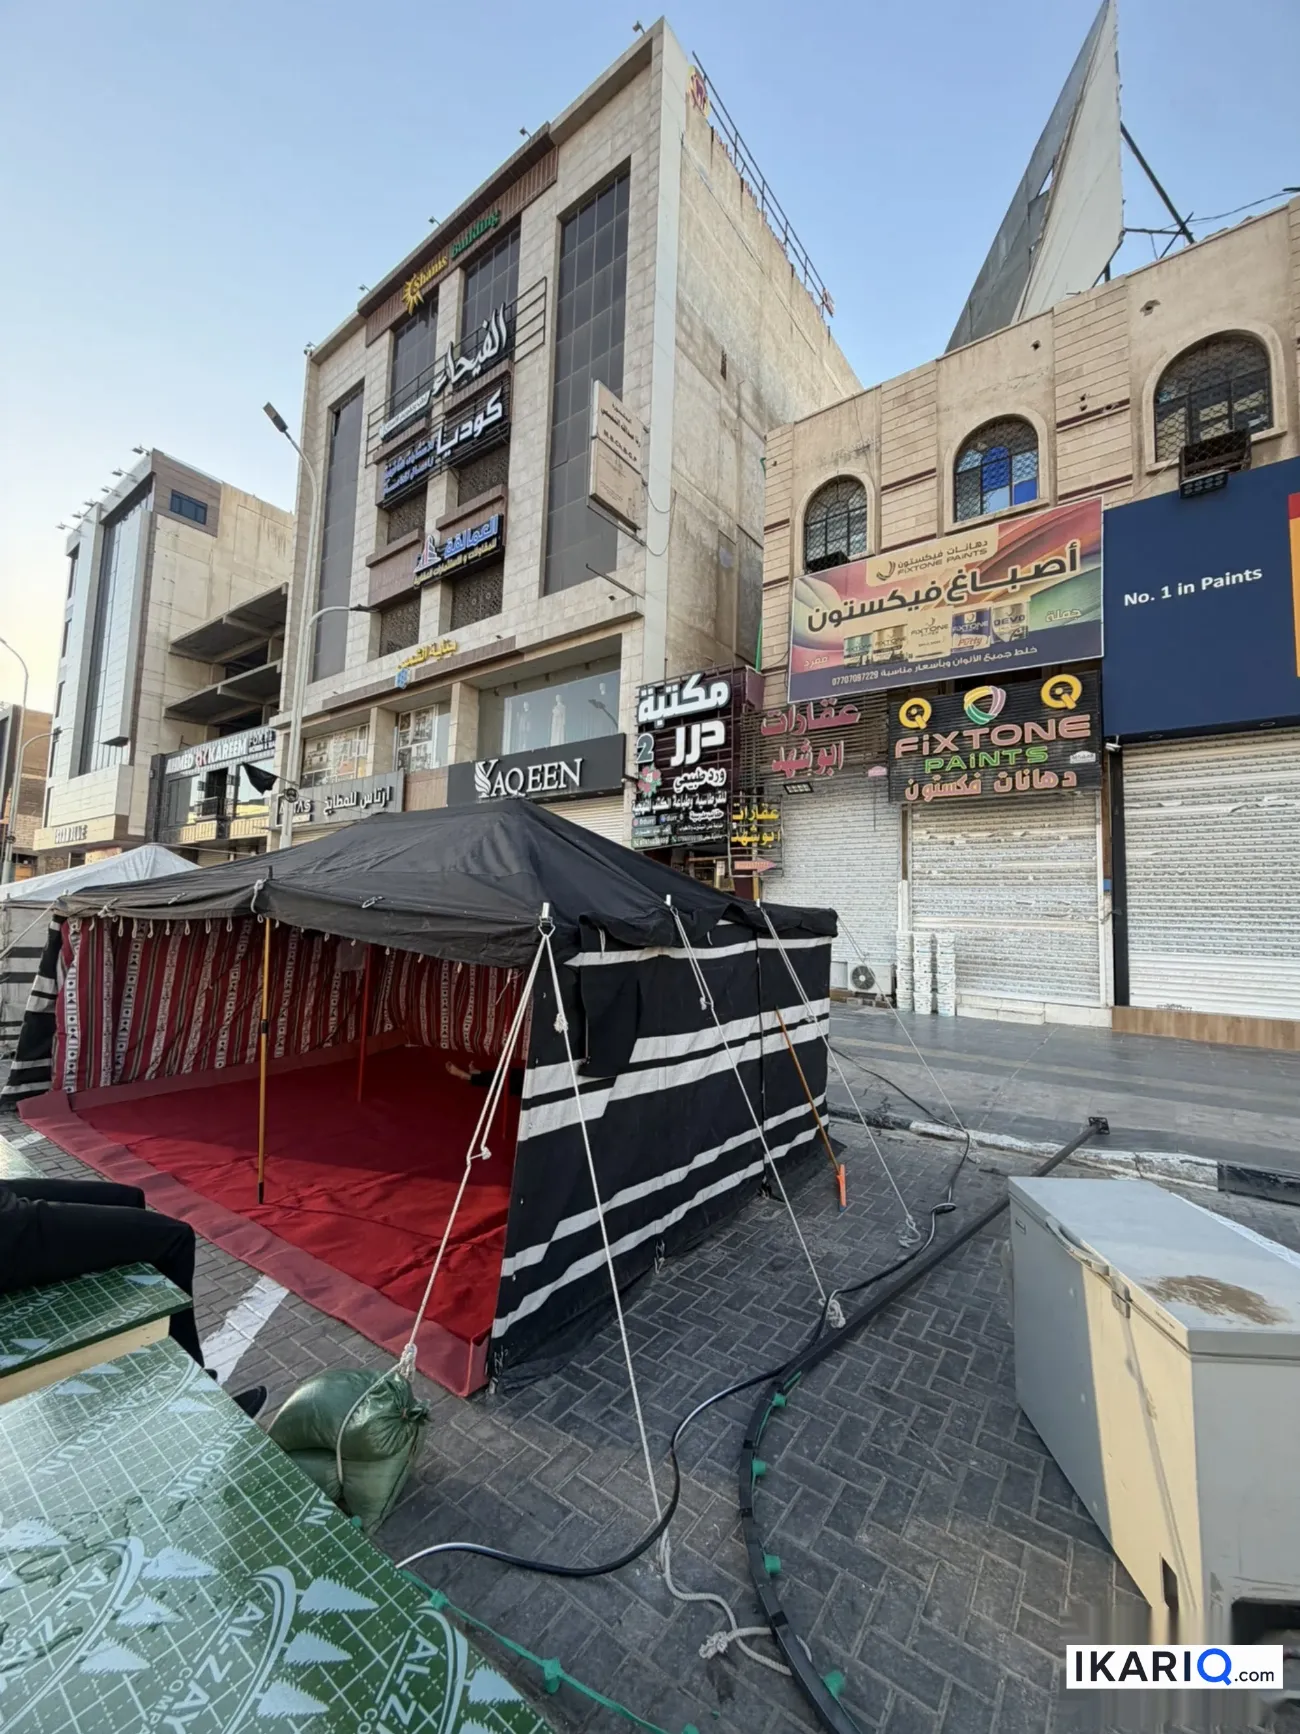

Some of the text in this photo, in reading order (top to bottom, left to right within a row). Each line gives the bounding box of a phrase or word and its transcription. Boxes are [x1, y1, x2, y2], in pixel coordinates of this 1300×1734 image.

[450, 209, 500, 260] Building
[432, 301, 507, 397] الفيحاء
[437, 386, 503, 459] كوديا
[444, 513, 499, 560] العمالقة
[897, 540, 988, 570] دهانات فيكستون
[807, 541, 1082, 633] أصباغ فيكستون
[1124, 568, 1263, 607] No. 1 in Paints
[1045, 606, 1082, 624] جملة
[803, 655, 829, 669] مفرد
[983, 651, 1012, 664] جميع
[1013, 646, 1038, 657] خلط
[880, 666, 913, 678] مناسبة
[638, 673, 731, 729] مكتبة
[760, 697, 862, 737] عقارات
[208, 738, 248, 764] KAREEM
[636, 732, 655, 765] 2
[670, 718, 725, 767] درر
[771, 738, 845, 779] ابو شهد
[673, 766, 727, 794] ورد طبيعي
[904, 769, 1078, 803] دهانات فكستون
[323, 790, 359, 816] للمطابخ
[652, 796, 672, 814] الكتب
[732, 802, 780, 821] عقارات
[730, 824, 761, 848] شهد
